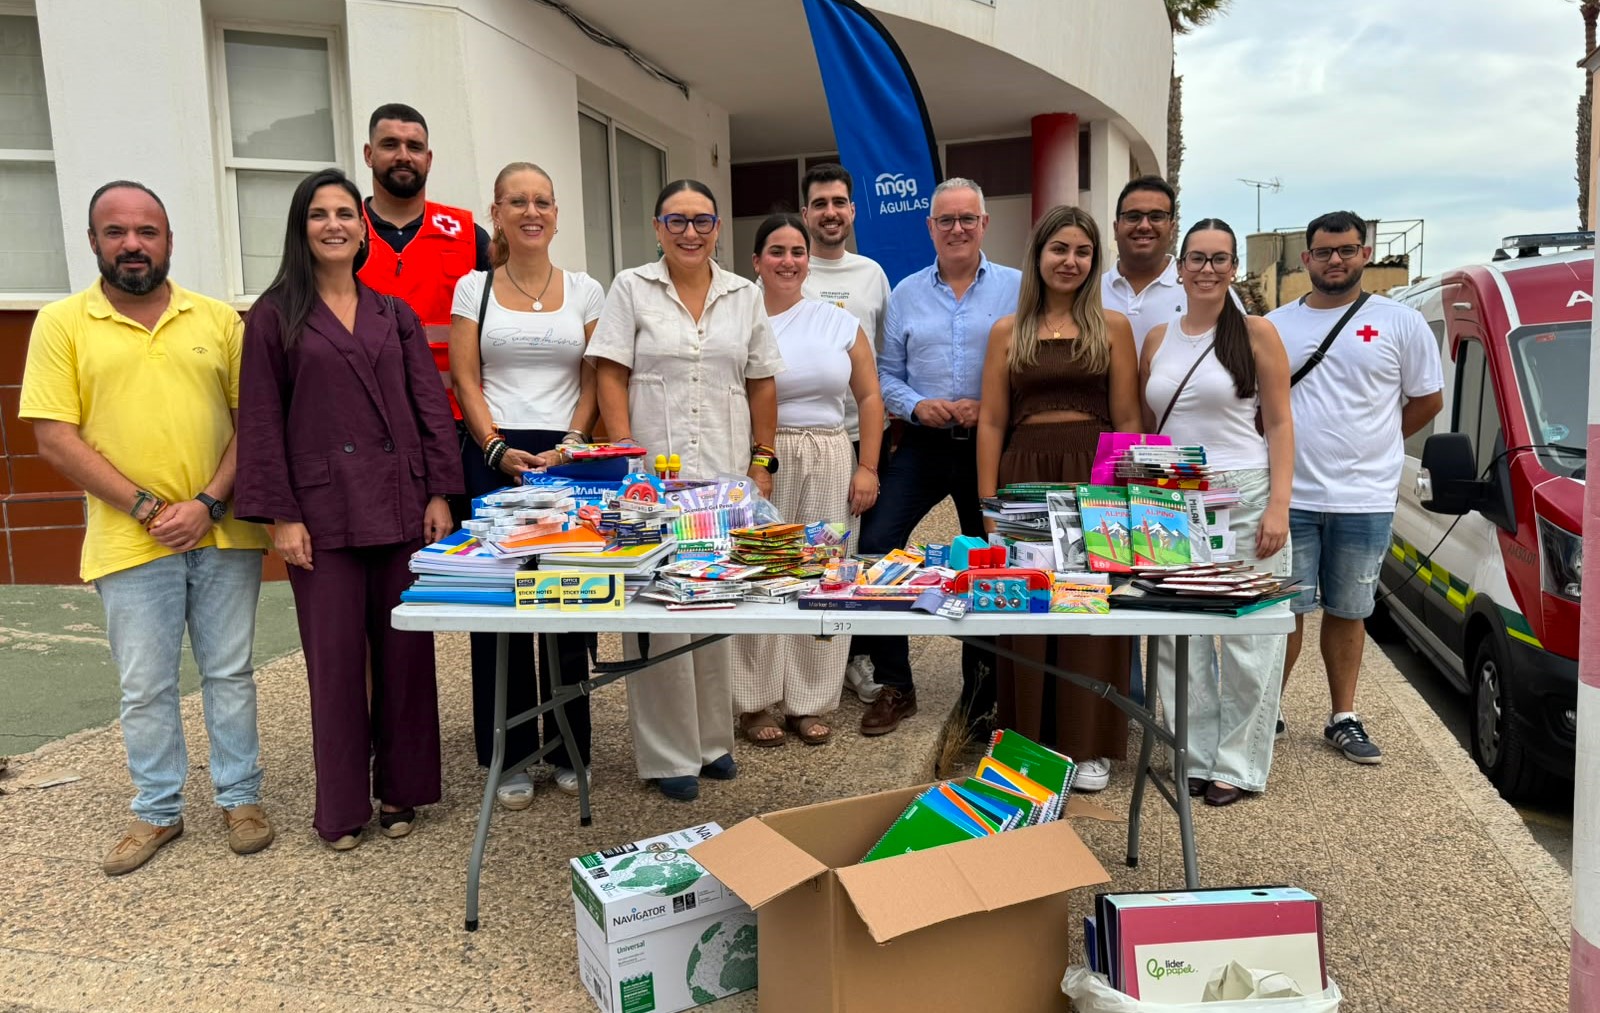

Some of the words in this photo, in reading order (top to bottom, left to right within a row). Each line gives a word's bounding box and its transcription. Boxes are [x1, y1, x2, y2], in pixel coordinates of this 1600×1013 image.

[875, 178, 918, 198] nngg
[879, 197, 929, 215] ÁGUILAS
[1105, 510, 1130, 518] ALPIN
[1145, 508, 1175, 518] ALPINO
[1188, 498, 1200, 524] MILAN
[613, 905, 666, 927] NAVIGATOR
[616, 940, 646, 954] Universal
[1165, 960, 1185, 968] lider
[1165, 964, 1195, 976] papel
